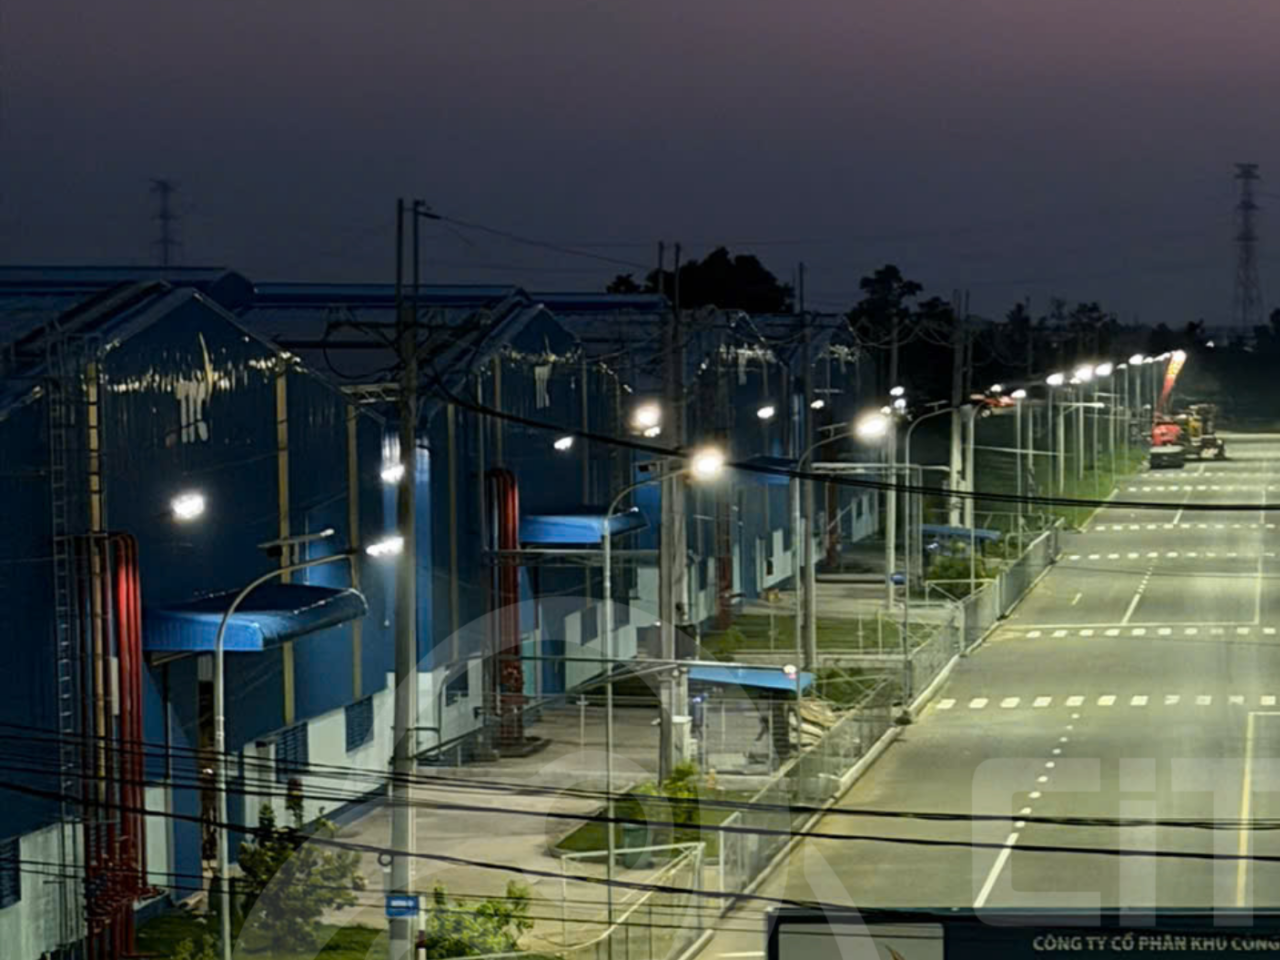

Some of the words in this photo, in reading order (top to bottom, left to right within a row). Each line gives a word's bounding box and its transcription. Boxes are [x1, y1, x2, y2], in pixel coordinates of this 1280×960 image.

[1033, 934, 1083, 951] CÔNG
[1085, 936, 1108, 951] TY
[1190, 936, 1227, 951] KHU
